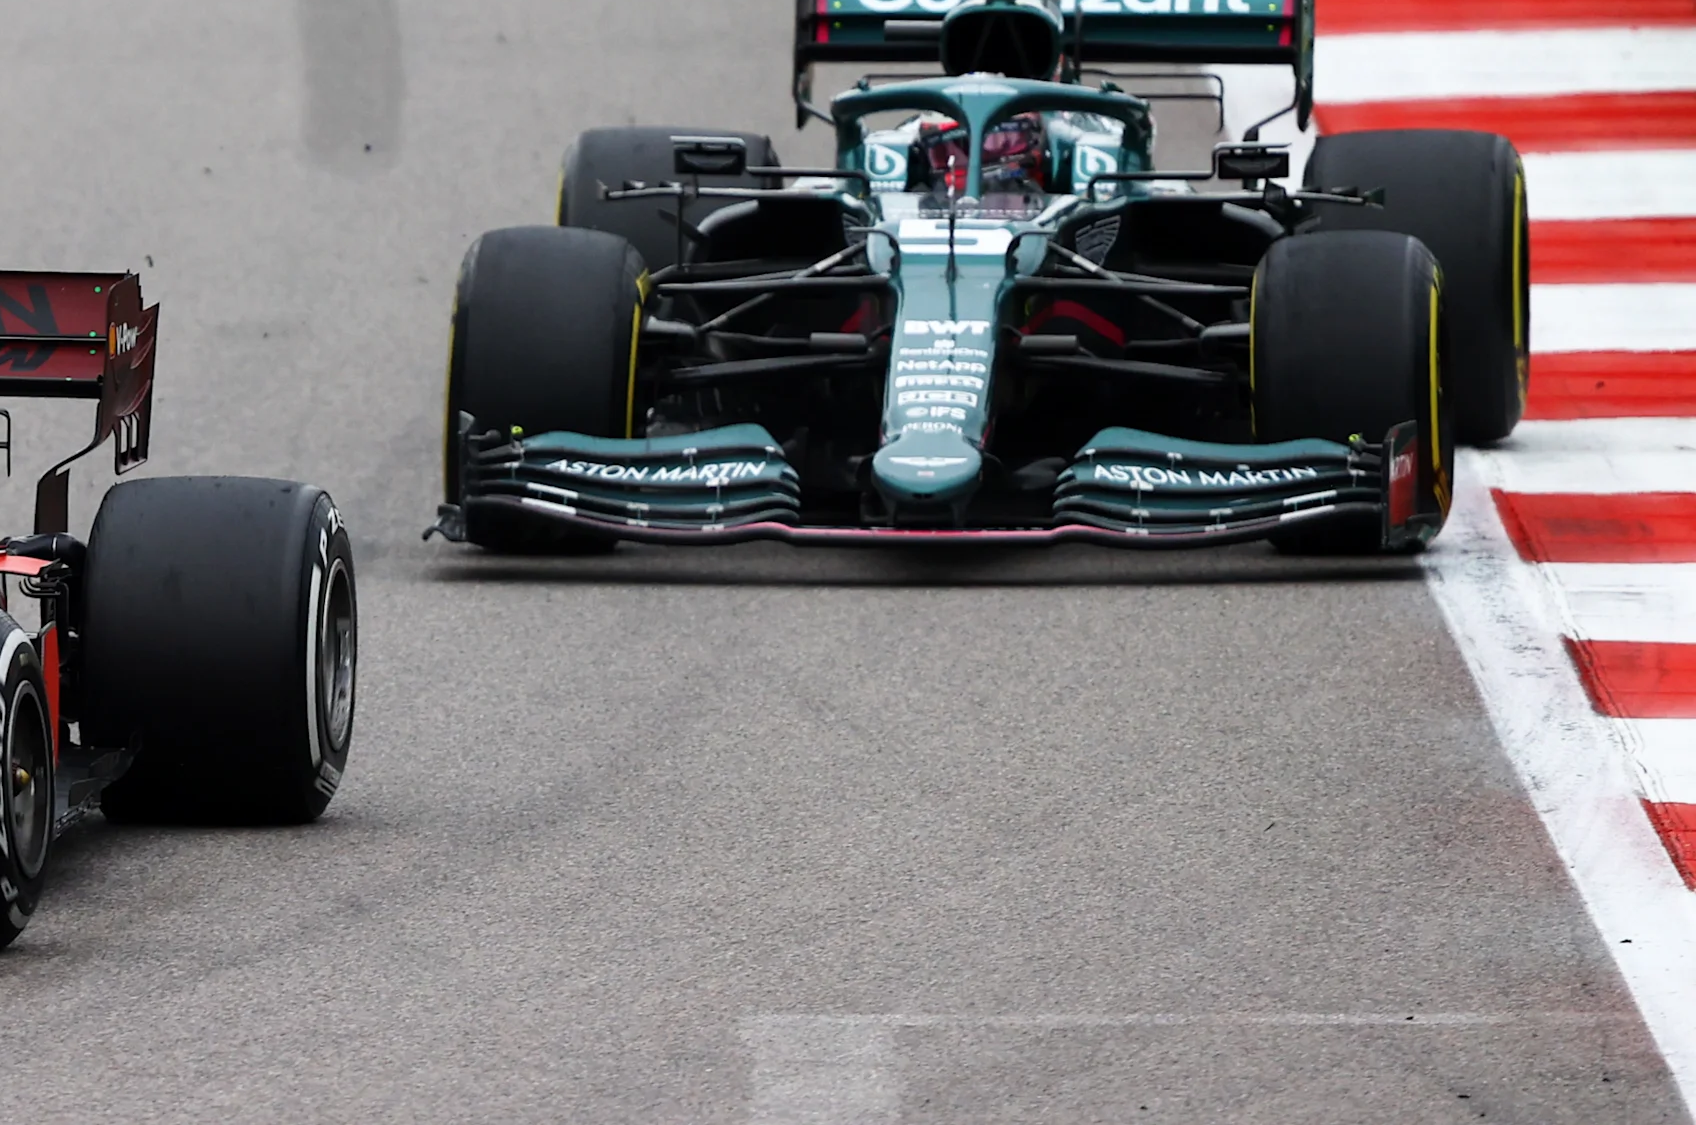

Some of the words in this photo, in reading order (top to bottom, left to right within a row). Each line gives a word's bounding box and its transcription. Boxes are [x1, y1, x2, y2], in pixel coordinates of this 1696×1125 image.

[904, 320, 990, 335] BWT
[896, 359, 987, 373] NetApp
[899, 391, 977, 408] JCB
[929, 406, 966, 420] IFS
[901, 422, 963, 434] PERONI
[545, 459, 645, 481] ASTON
[652, 461, 766, 483] MARTIN
[1094, 464, 1192, 486] ASTON
[1197, 466, 1318, 486] MARTIN
